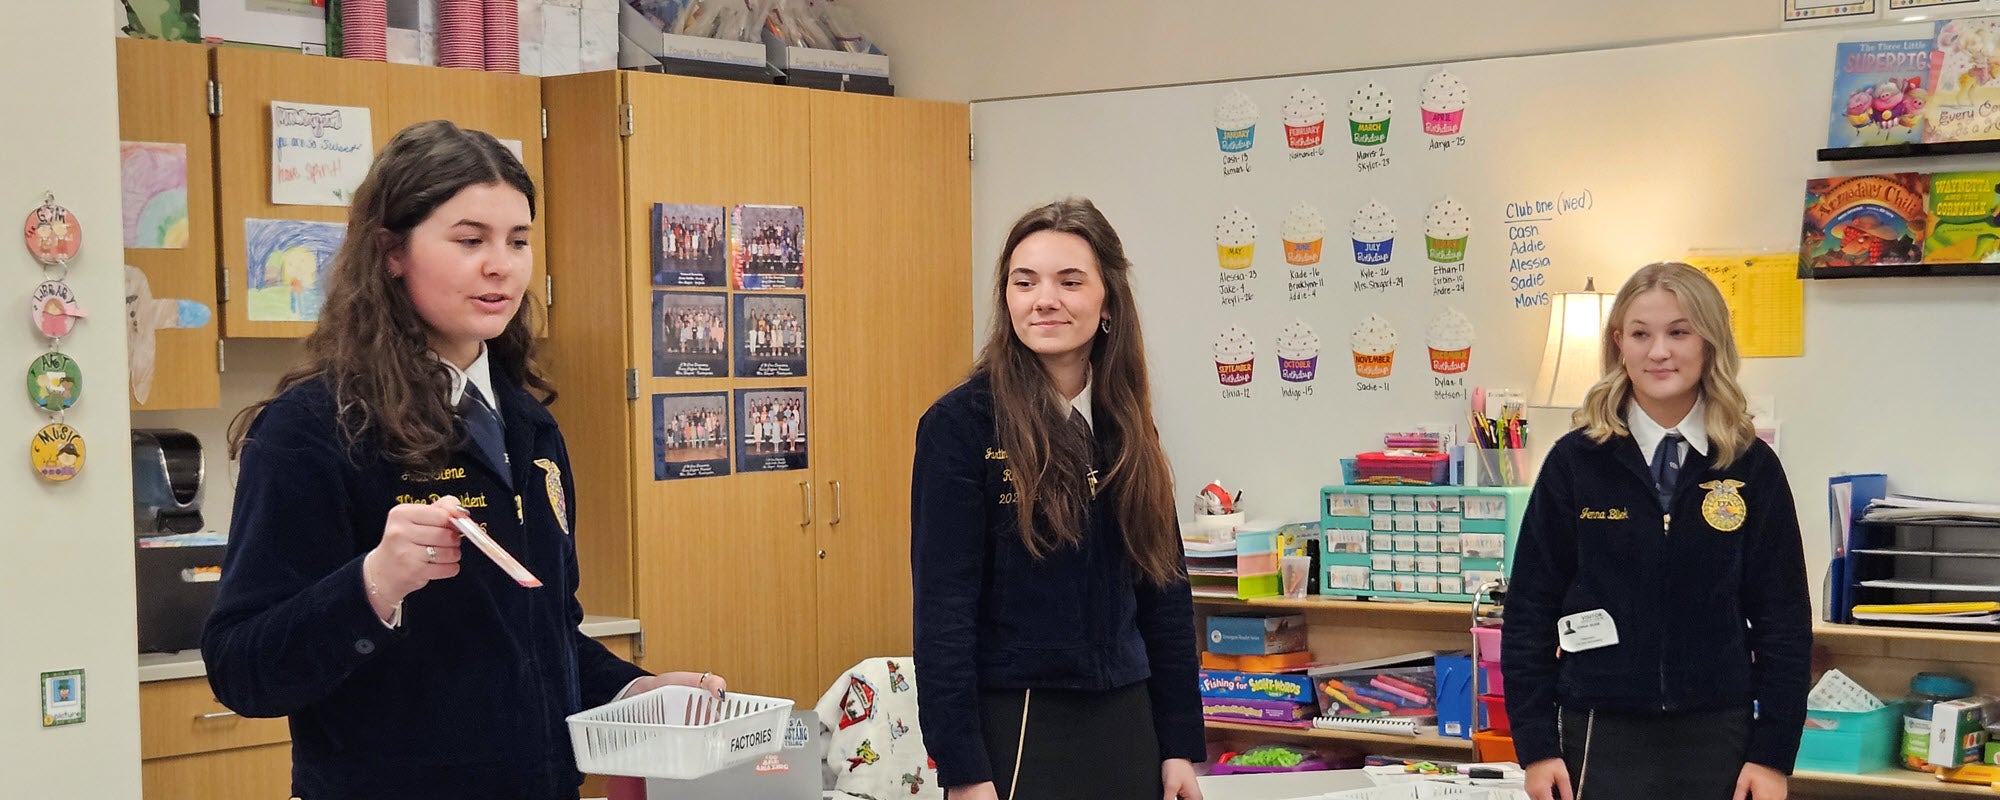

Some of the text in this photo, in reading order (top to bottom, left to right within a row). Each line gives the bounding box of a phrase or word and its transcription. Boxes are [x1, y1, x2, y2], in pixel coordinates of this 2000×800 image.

[1878, 42, 1901, 50] Three
[1904, 41, 1926, 49] Little
[1433, 113, 1452, 121] APRIL
[1939, 110, 1975, 125] Every
[1289, 126, 1320, 136] FEBRUARY
[1358, 123, 1382, 131] MARCH
[1426, 122, 1458, 133] Birthday
[1225, 130, 1250, 139] JANUARY
[1354, 132, 1385, 142] Birthday
[1222, 140, 1252, 150] Birthday
[1290, 136, 1320, 146] Birthday
[1936, 179, 1991, 193] WAYNETTA
[1884, 183, 1917, 215] Chili
[1506, 201, 1533, 218] Club
[1936, 202, 1987, 216] CORNSTALK
[37, 206, 66, 224] GYM
[1509, 224, 1539, 240] Cash
[1295, 243, 1310, 251] JUNE
[1365, 243, 1381, 251] JULY
[1510, 239, 1546, 256] Addie
[1357, 252, 1389, 262] Birthday
[1510, 257, 1551, 272] Alessia
[1511, 272, 1545, 291] Sadie
[34, 284, 76, 304] LIBRARY
[1515, 291, 1550, 308] Mavis
[42, 354, 70, 370] ART
[1356, 355, 1391, 363] NOVEMBER
[1433, 359, 1466, 370] Birthday
[1219, 364, 1252, 373] SEPTEMBER
[1282, 369, 1313, 379] Birthday
[1221, 373, 1250, 382] Birthday
[38, 426, 81, 444] MUSIC
[1203, 677, 1235, 691] Fishing
[55, 711, 81, 719] picture
[730, 728, 773, 752] FACTORIES
